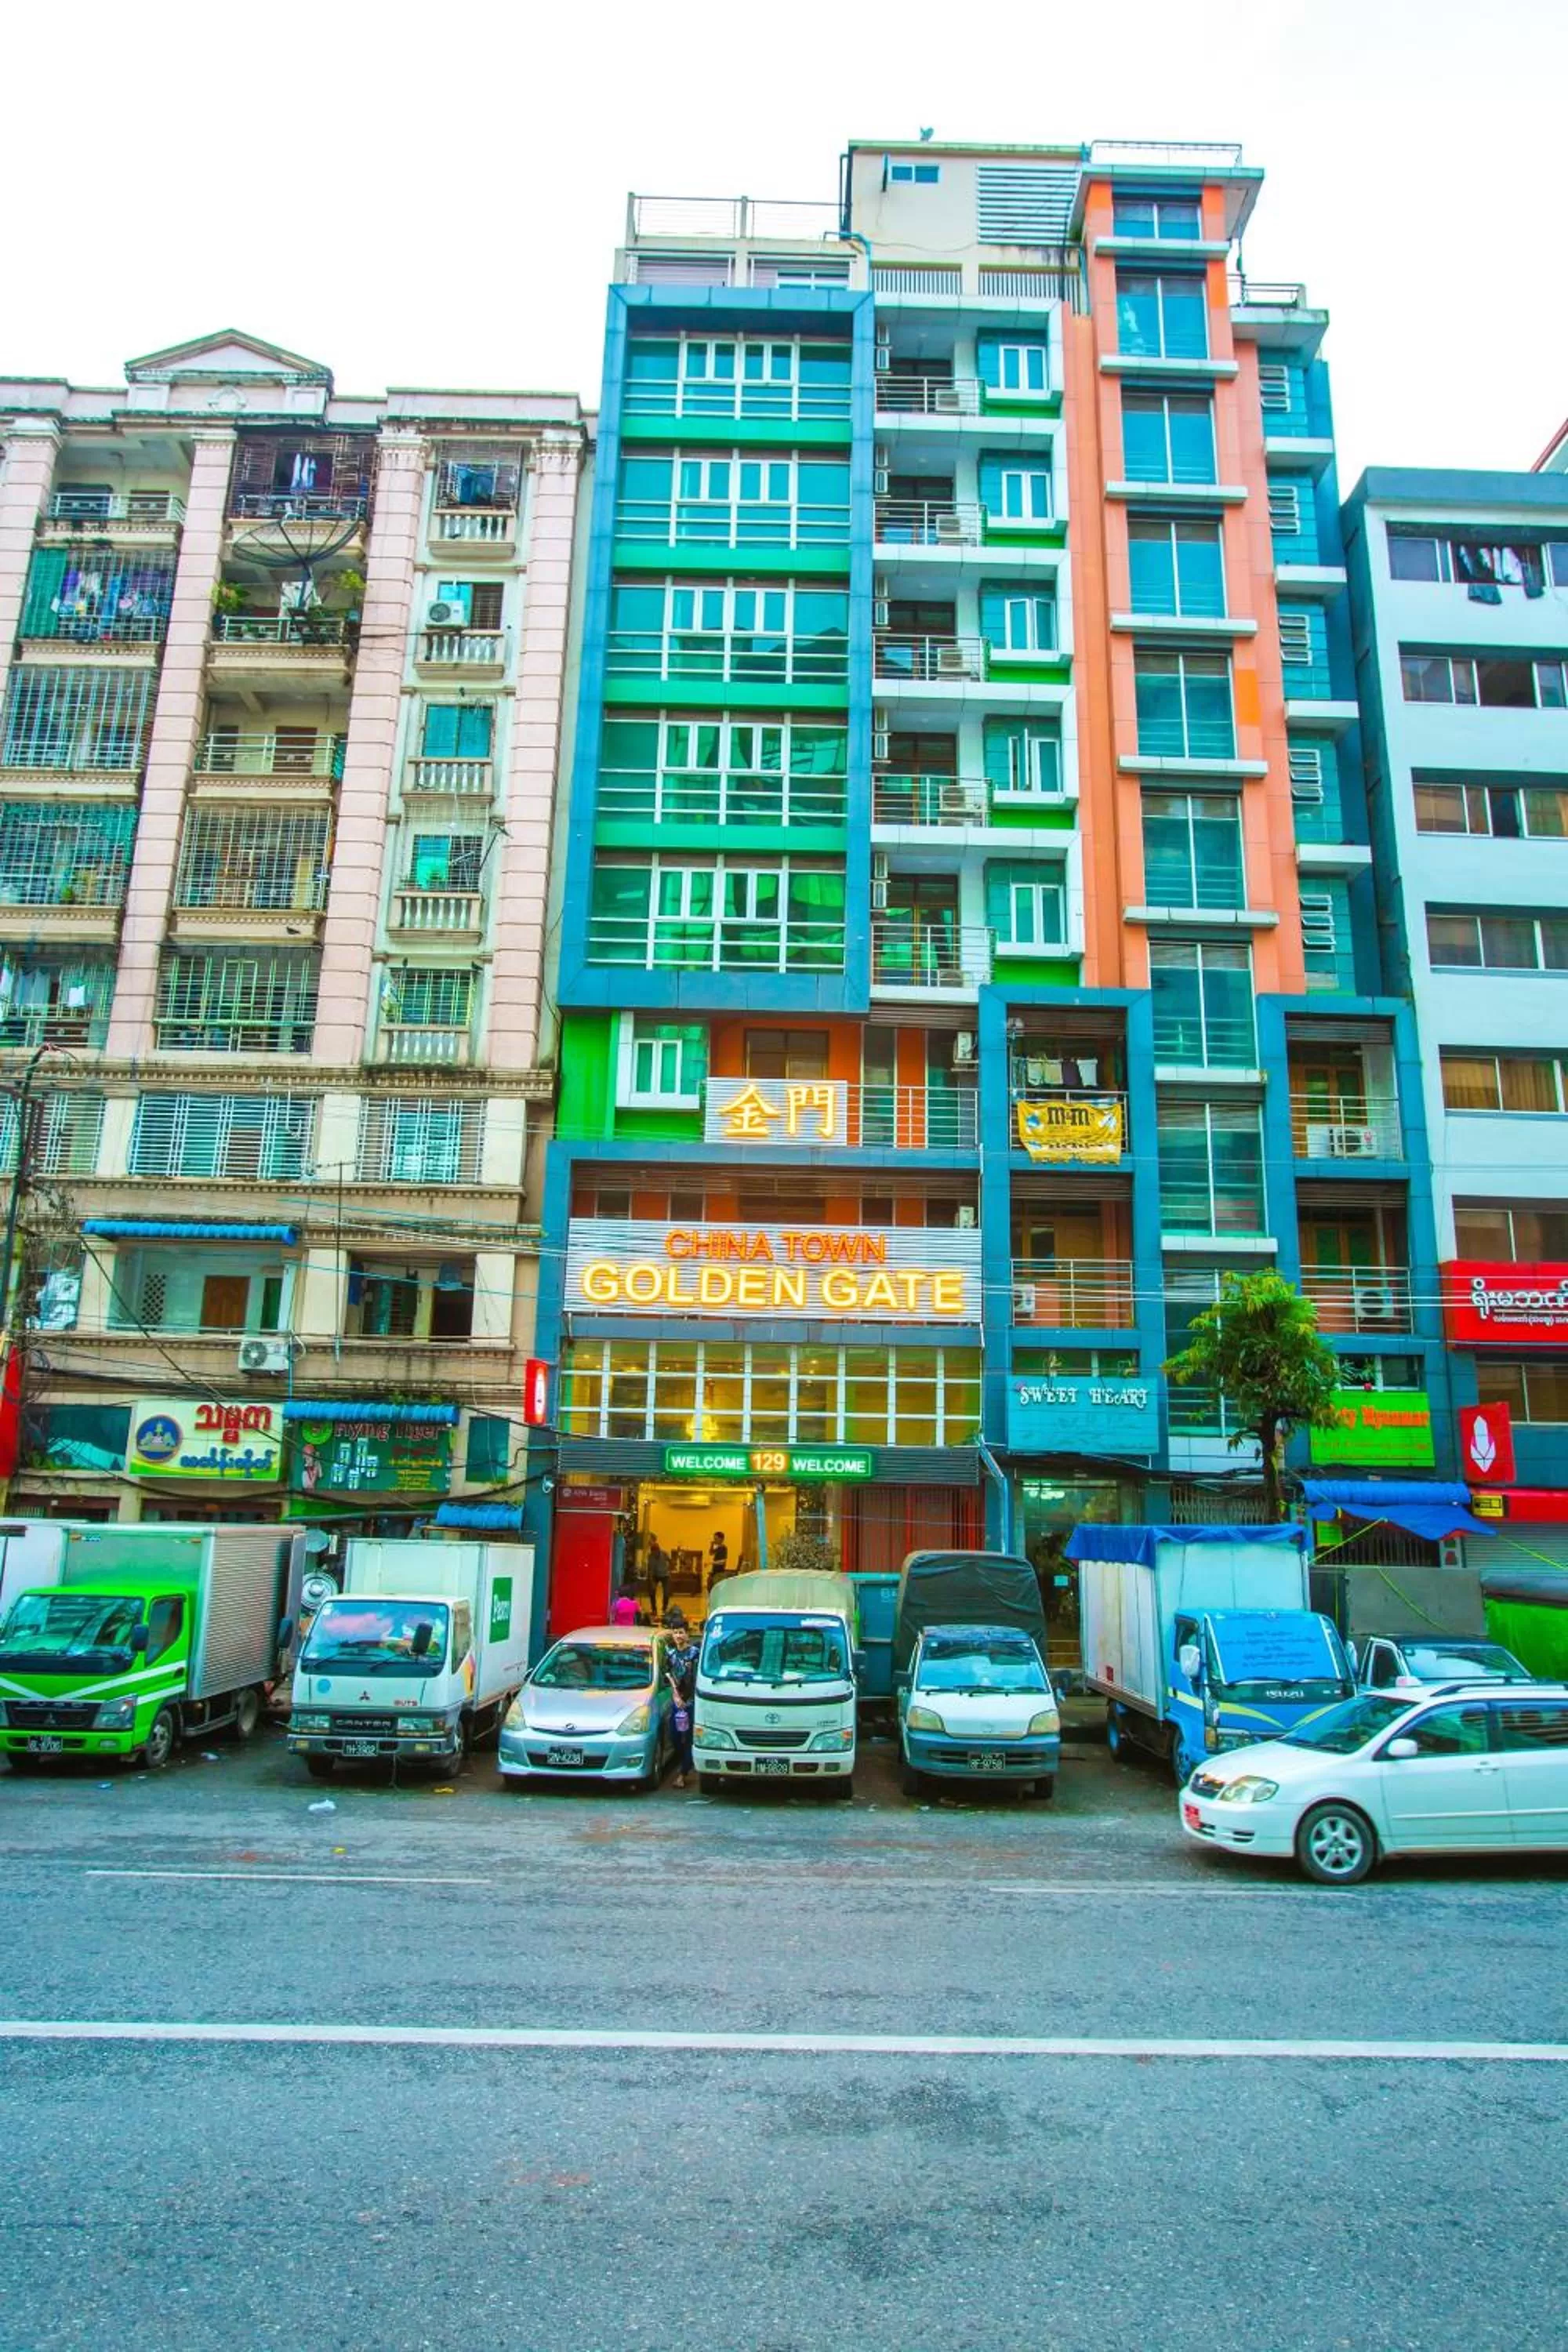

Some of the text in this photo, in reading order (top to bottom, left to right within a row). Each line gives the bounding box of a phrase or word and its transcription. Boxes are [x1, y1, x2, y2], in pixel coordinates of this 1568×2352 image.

[716, 1083, 836, 1138] 金門
[663, 1229, 886, 1264] CHINA TOWN
[582, 1261, 967, 1313] GOLDEN GATE
[1019, 1383, 1149, 1409] SWEET HEART
[671, 1453, 866, 1473] WELCOME 129 WELCOME
[1265, 1690, 1305, 1700] ISUZU
